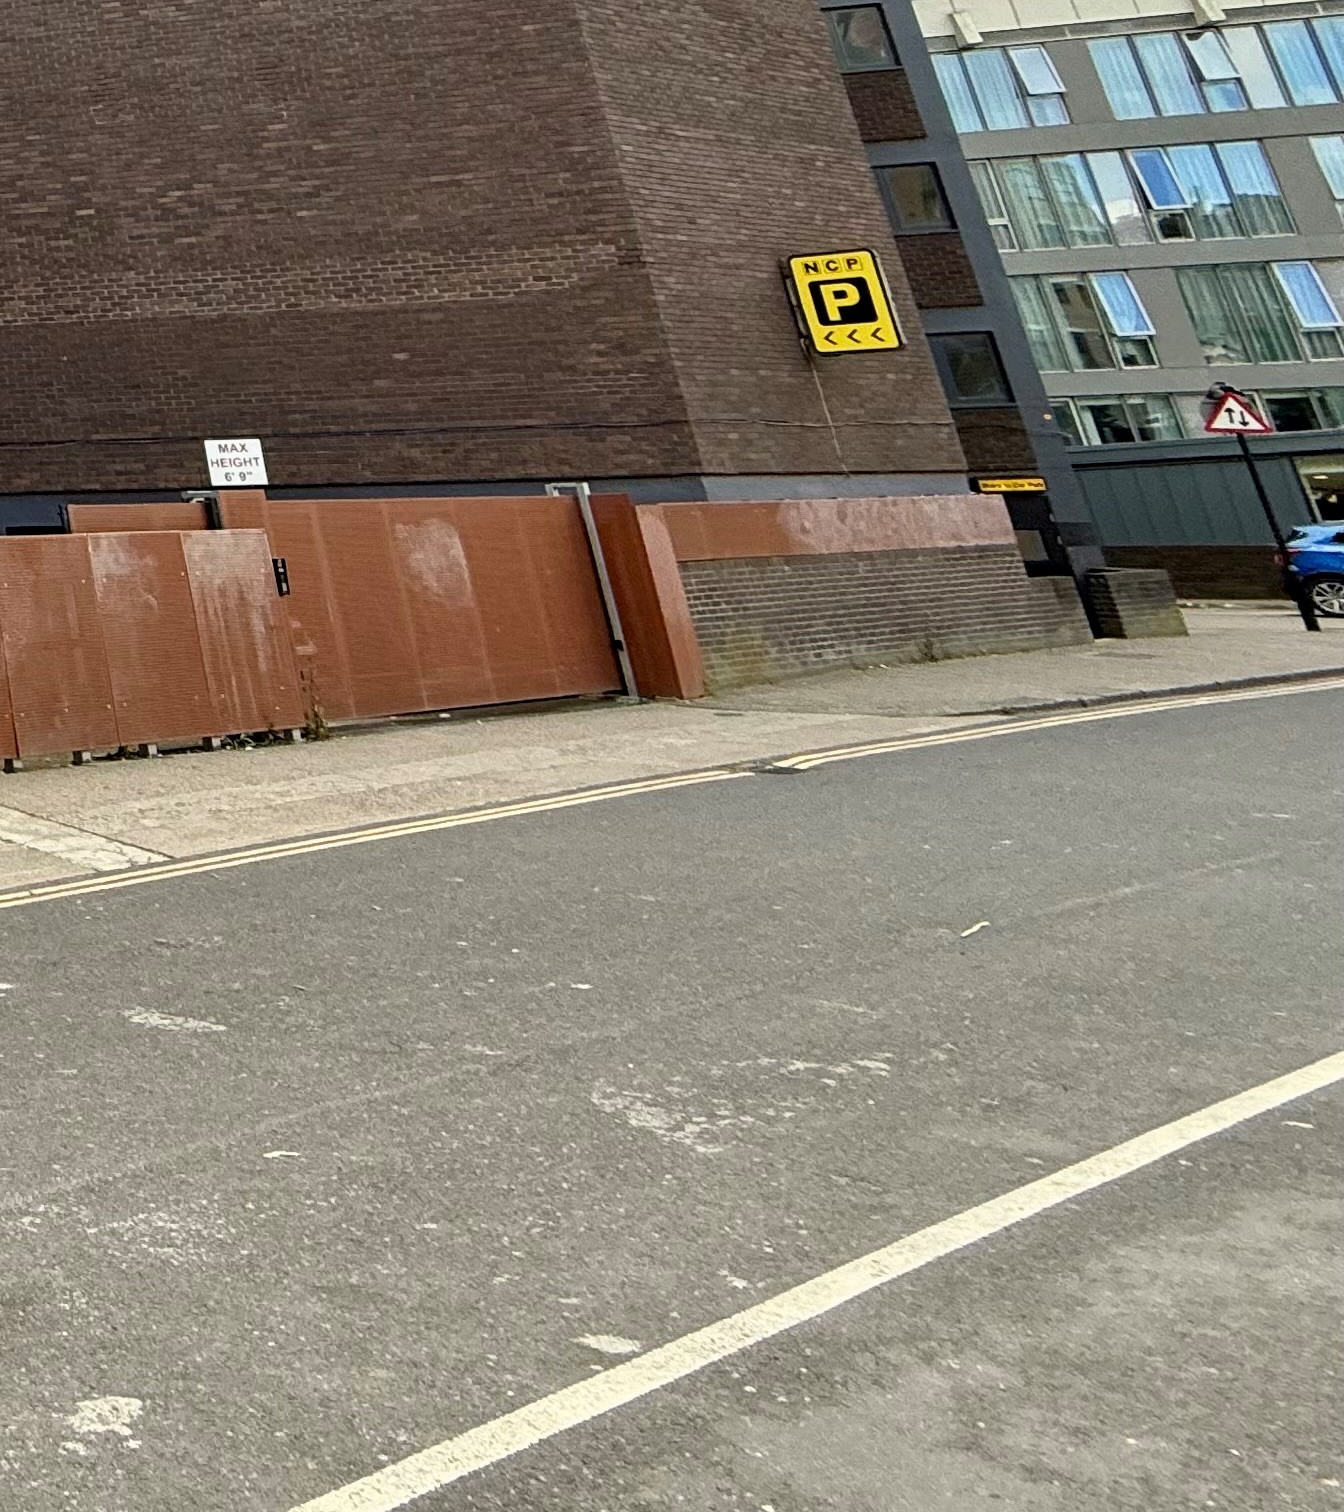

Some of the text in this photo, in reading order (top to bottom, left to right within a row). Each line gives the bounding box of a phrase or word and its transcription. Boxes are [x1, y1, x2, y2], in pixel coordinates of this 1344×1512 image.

[803, 258, 859, 274] NCP
[819, 282, 861, 322] P
[218, 443, 248, 453] MAX
[210, 457, 260, 468] HEIGHT
